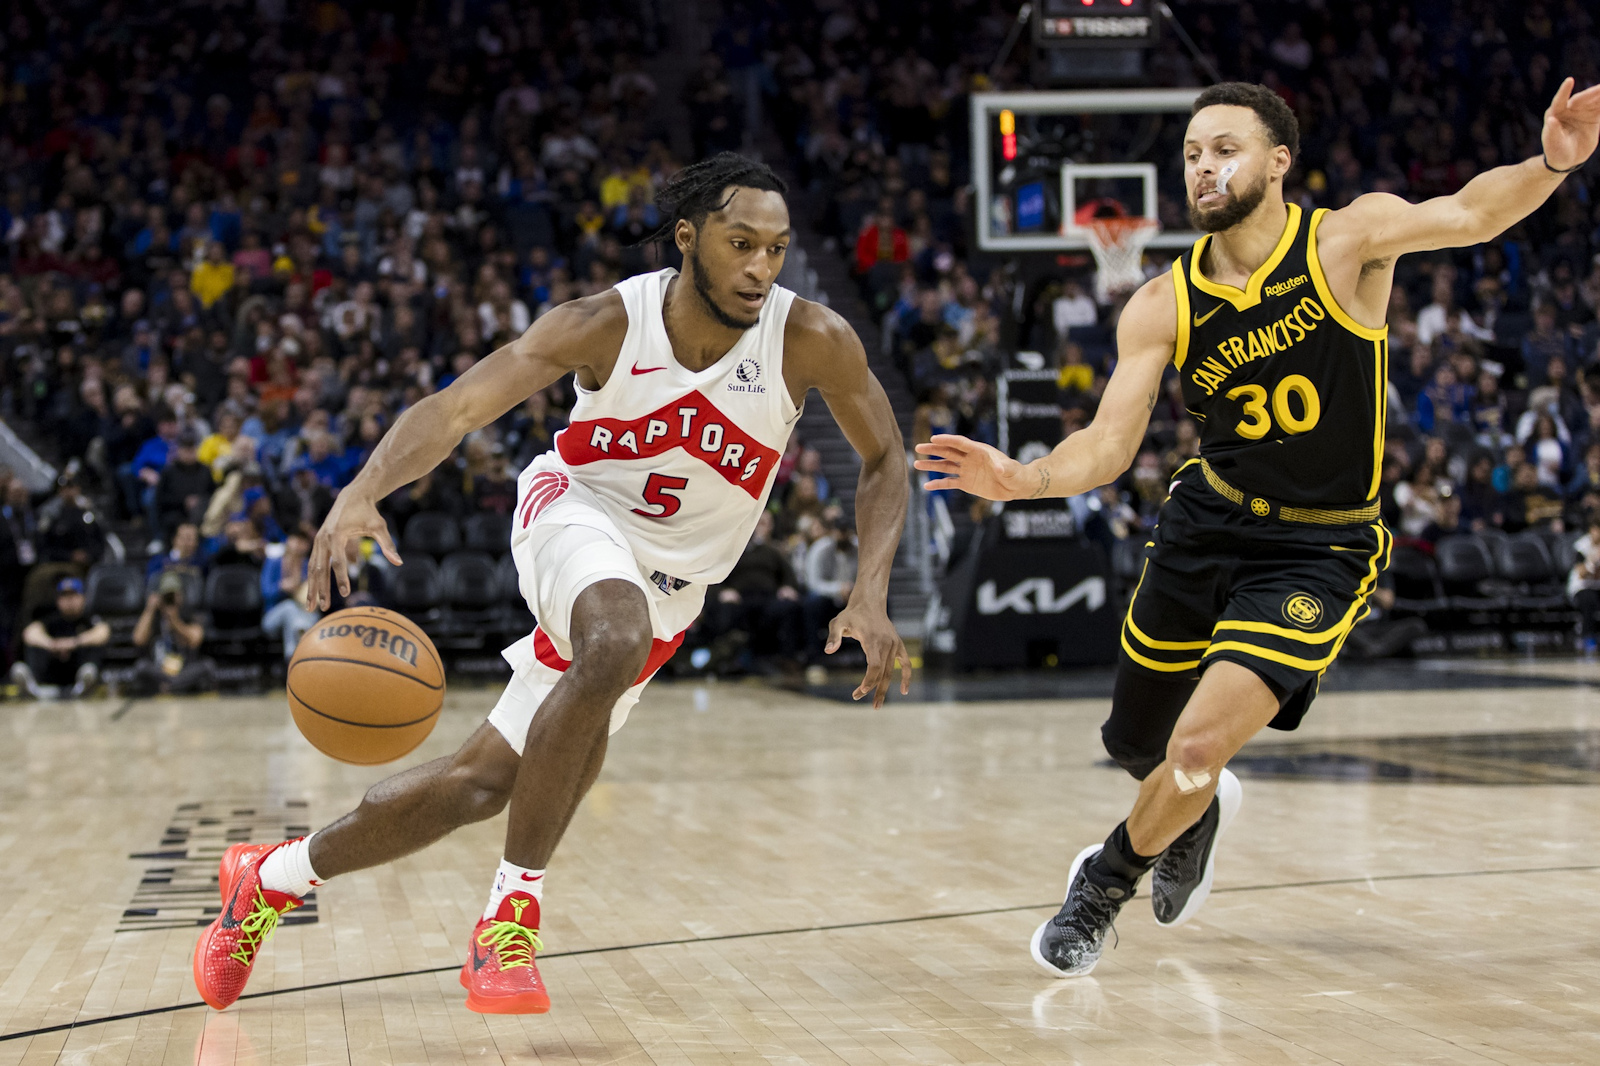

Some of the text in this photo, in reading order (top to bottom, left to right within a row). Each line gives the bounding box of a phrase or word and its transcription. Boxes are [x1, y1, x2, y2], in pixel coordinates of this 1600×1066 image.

[1264, 274, 1309, 297] Rakuten
[1191, 297, 1326, 396] SAN FRANCISCO
[727, 383, 766, 394] Sun Life
[1225, 374, 1321, 440] 30
[590, 407, 762, 482] RAPTORS
[630, 472, 689, 518] 5
[318, 624, 419, 668] Wilson
